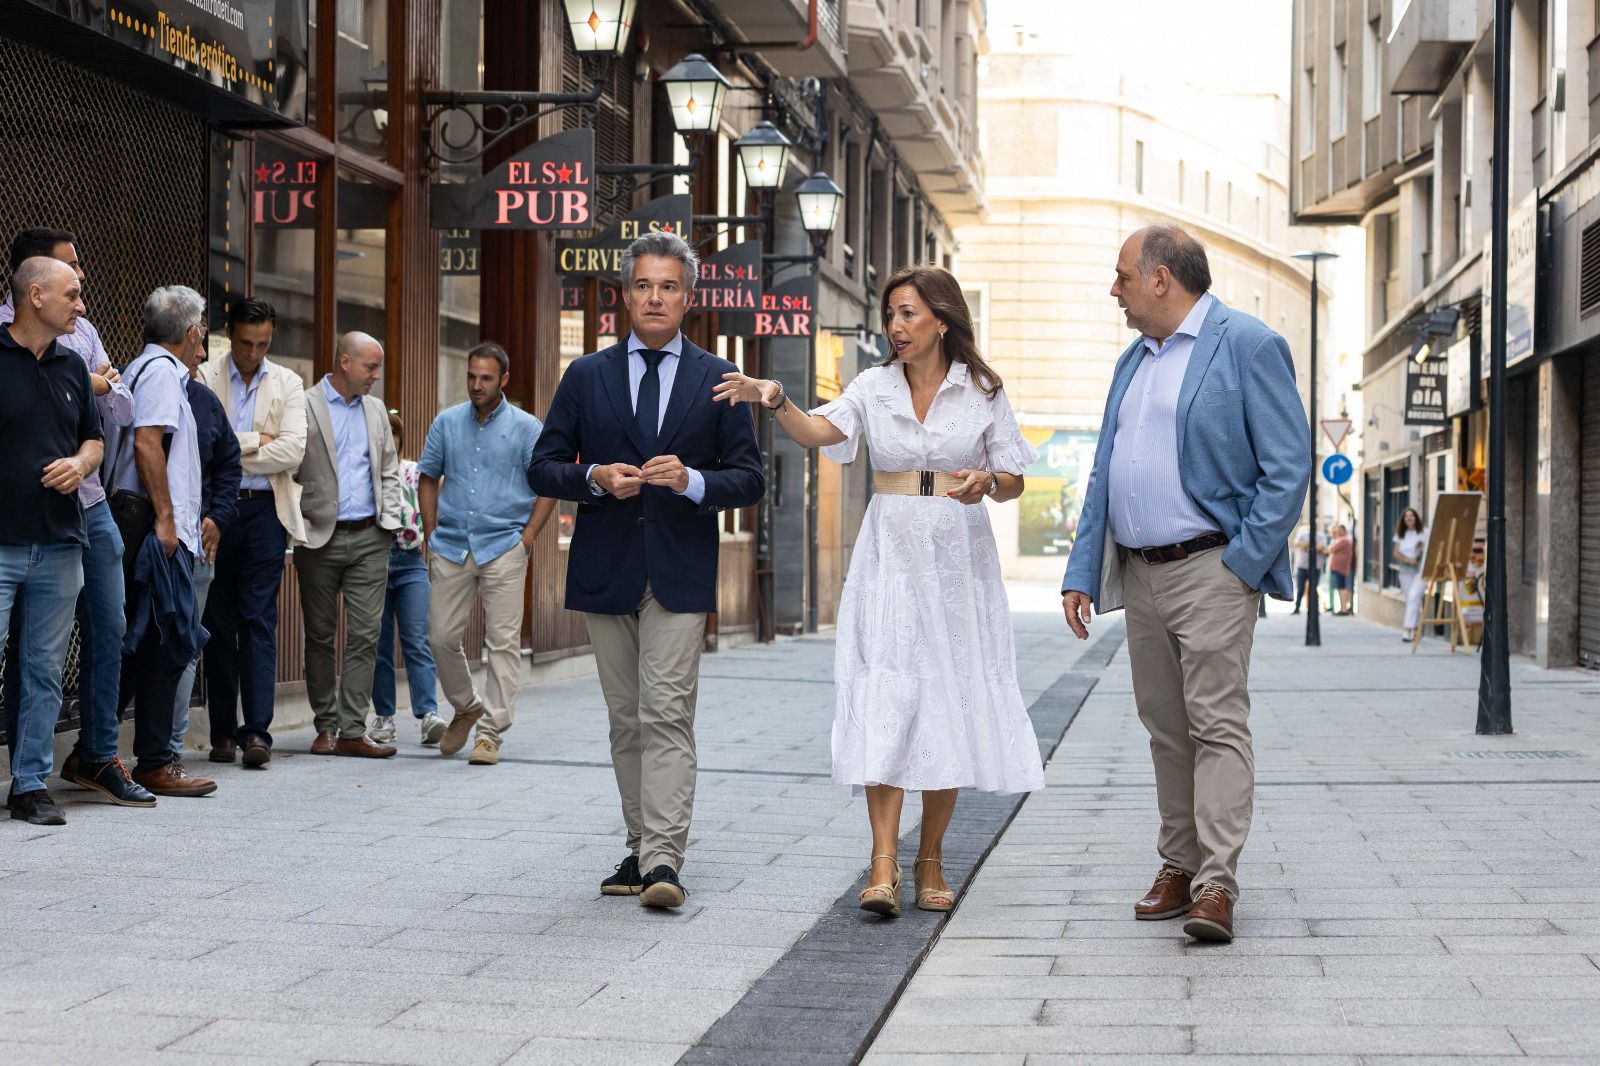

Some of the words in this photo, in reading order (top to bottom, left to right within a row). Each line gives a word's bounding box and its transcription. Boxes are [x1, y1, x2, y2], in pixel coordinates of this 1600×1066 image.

[158, 10, 197, 65] Tienda
[200, 40, 237, 83] erótica
[508, 162, 537, 184] EL
[494, 190, 589, 225] PUB
[701, 263, 720, 281] EL
[762, 294, 780, 310] EL
[753, 312, 812, 336] BAR
